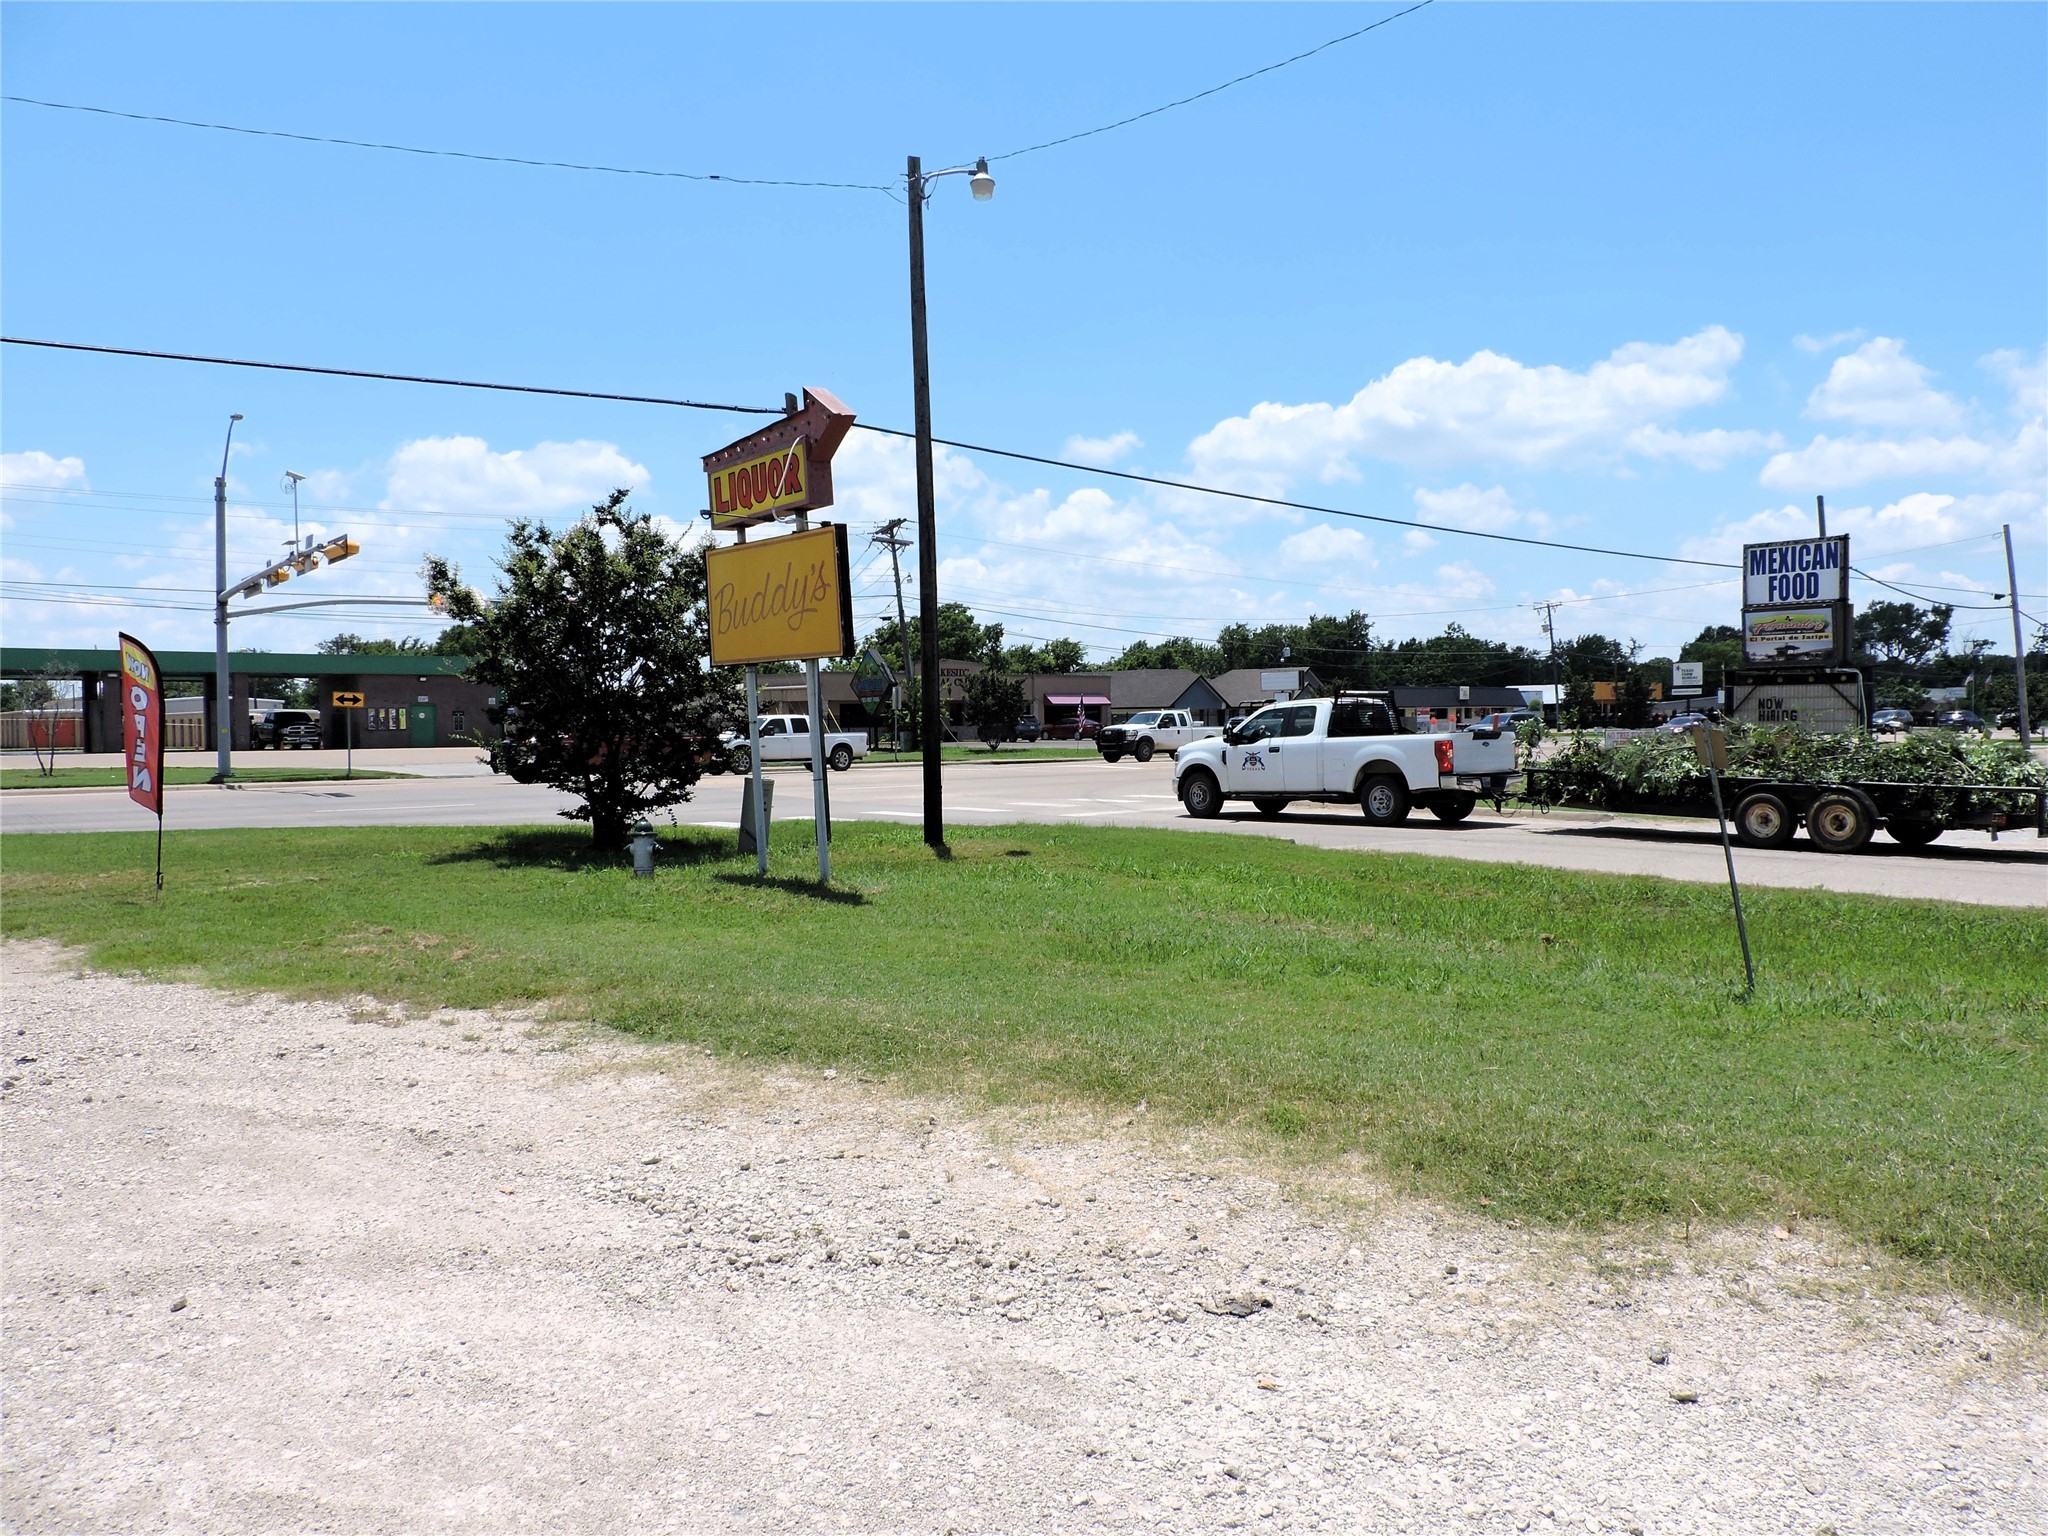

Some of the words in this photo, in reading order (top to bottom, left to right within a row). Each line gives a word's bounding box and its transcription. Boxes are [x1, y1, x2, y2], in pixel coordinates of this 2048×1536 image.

[713, 452, 803, 513] LIQUOR
[1750, 542, 1838, 576] MEXICAN
[714, 560, 831, 635] Buddy's
[1767, 572, 1820, 602] FOOD
[1802, 633, 1830, 641] Jaripo
[1758, 698, 1784, 710] NOW
[1758, 709, 1798, 722] HIRING
